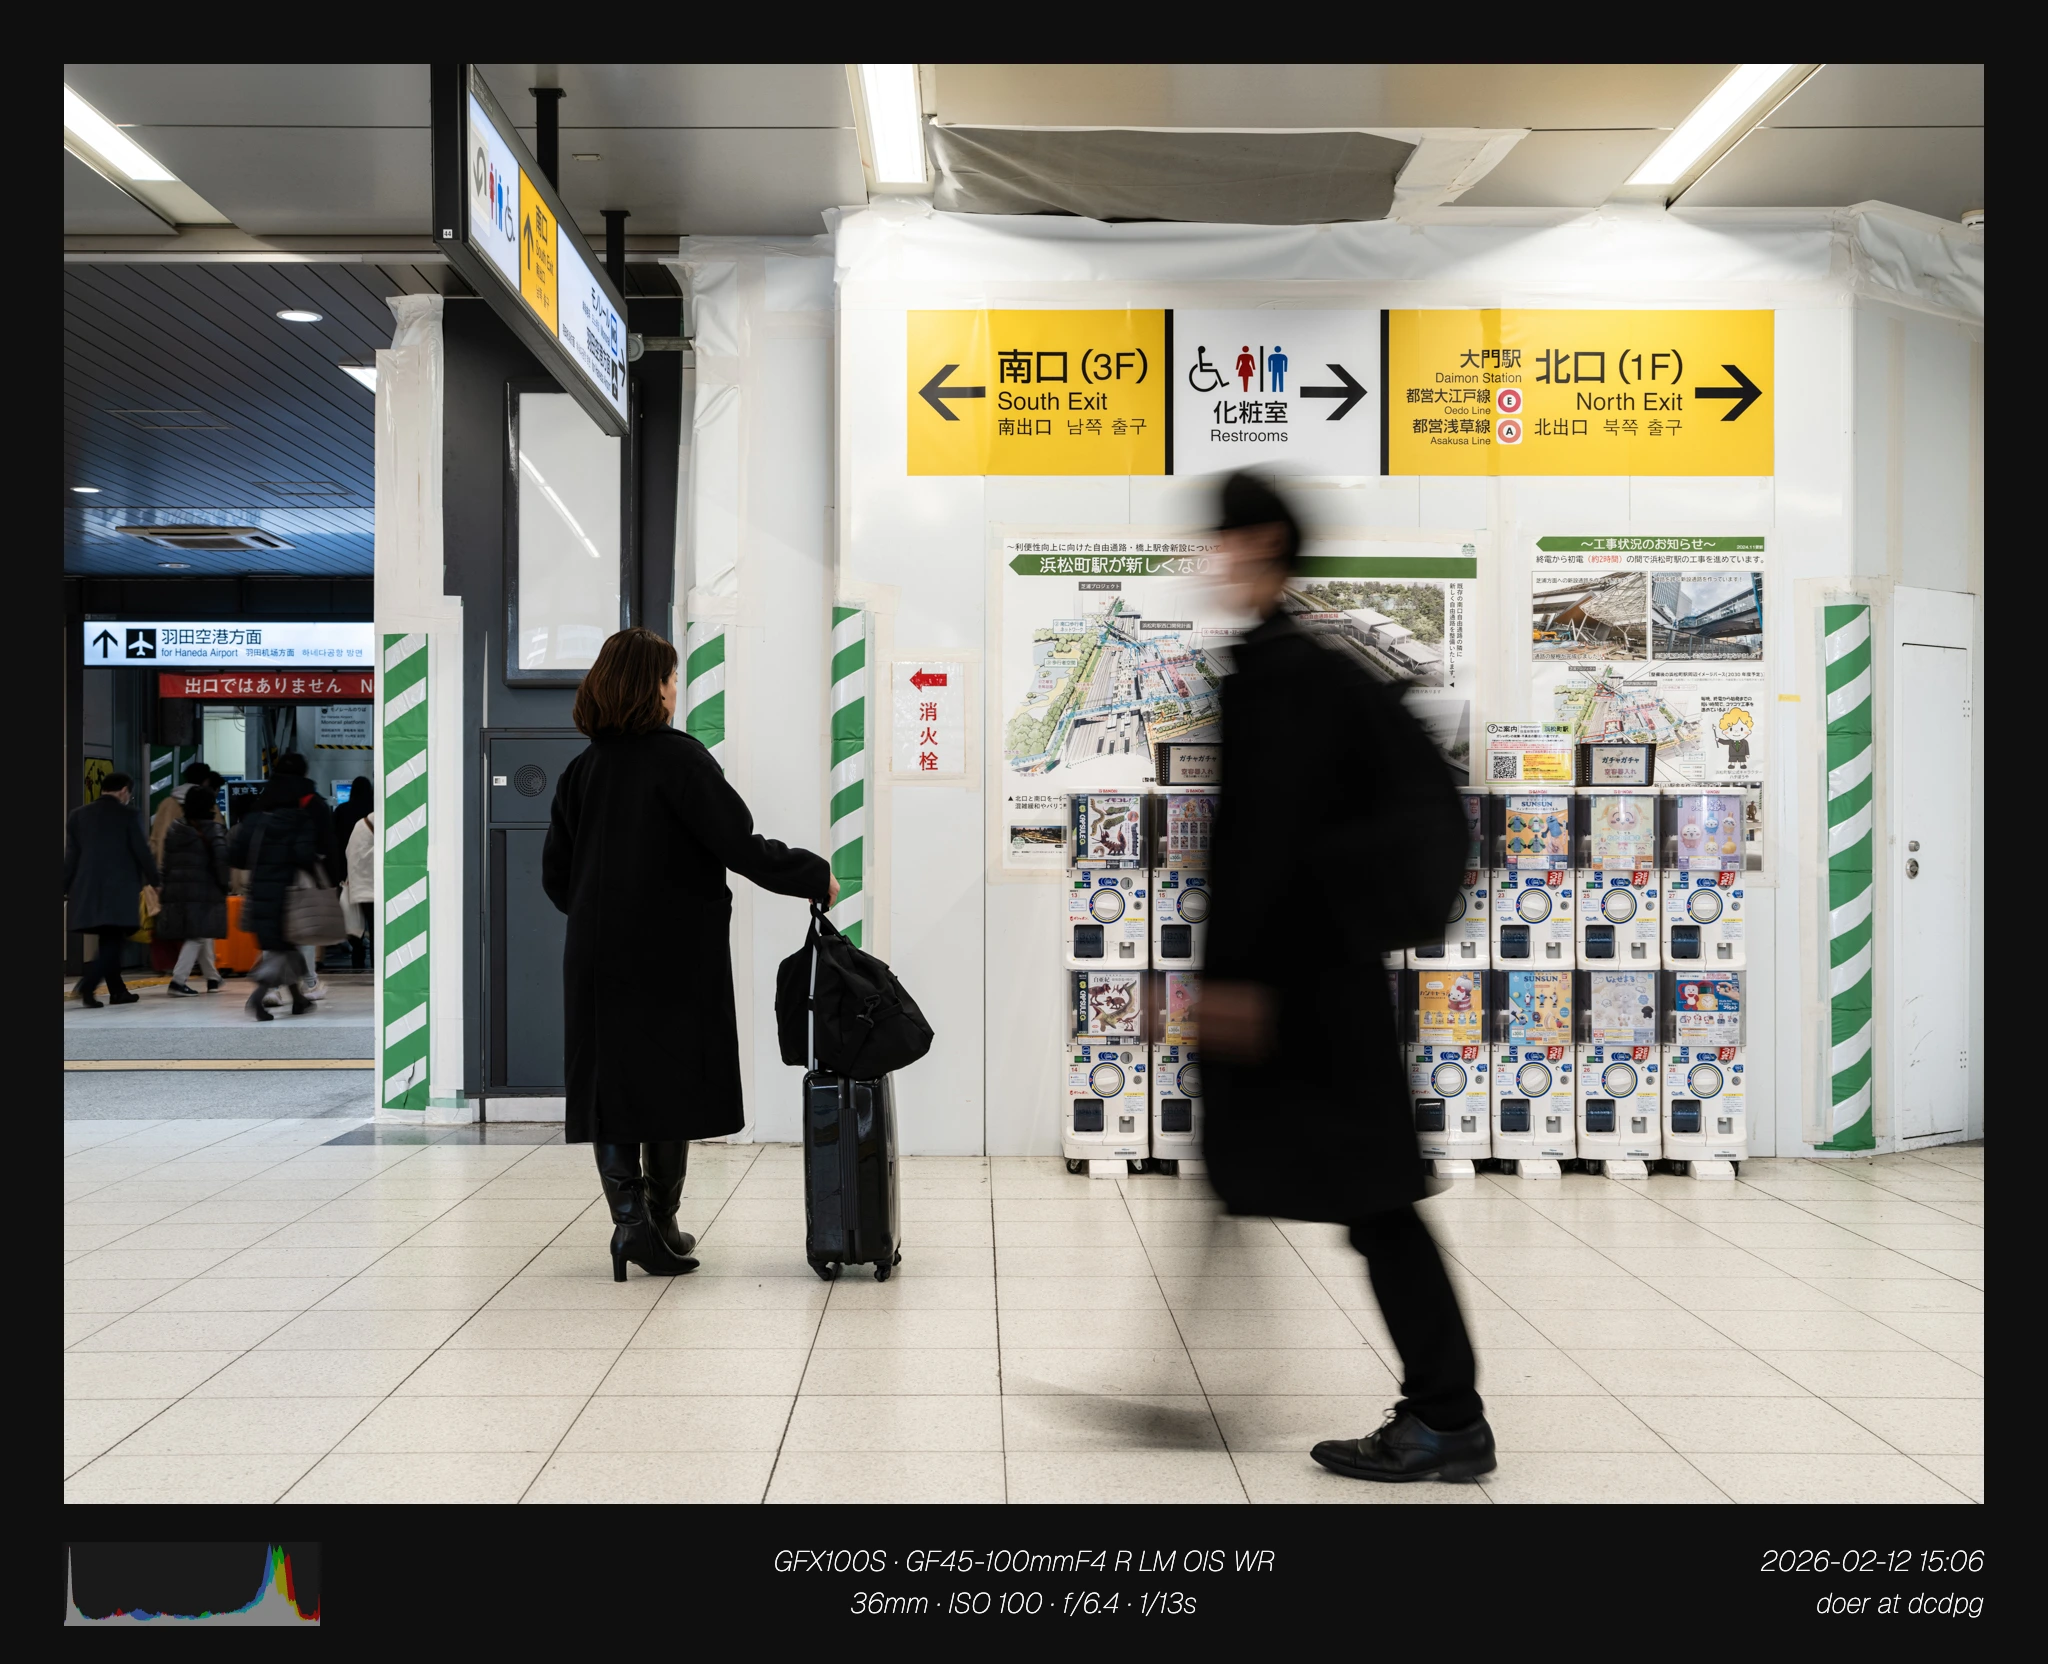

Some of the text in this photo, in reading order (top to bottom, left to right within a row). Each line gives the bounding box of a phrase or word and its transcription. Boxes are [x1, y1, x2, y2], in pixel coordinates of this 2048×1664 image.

[997, 348, 1148, 384] 南口 (3F)
[1459, 349, 1522, 370] 大門駅
[1535, 348, 1683, 385] 北口 (1F)
[1435, 372, 1522, 384] Daimon Station
[998, 391, 1108, 411] South Exit
[1406, 388, 1491, 404] 都営大江戸線
[1576, 393, 1683, 411] North Exit
[1213, 400, 1288, 425] 化粧室
[1444, 406, 1491, 415] Oedo Line
[998, 417, 1052, 436] 南出口
[1067, 417, 1148, 436] 남쪽 출구
[1412, 418, 1491, 434] 都営浅草線
[1534, 418, 1588, 436] 北出口
[1603, 418, 1683, 436] 북쪽 출구
[1210, 429, 1288, 442] Restrooms
[1430, 436, 1491, 445] Asakusa Line
[161, 628, 262, 646] 羽田空港方面
[161, 648, 238, 659] for Haneda Airport
[245, 649, 295, 657] 羽田机场方面
[185, 677, 342, 694] 出口ではありません
[361, 679, 374, 693] N
[919, 702, 938, 771] 消火栓
[1498, 725, 1518, 733] ご案内
[1544, 725, 1569, 733] 浜松町駅
